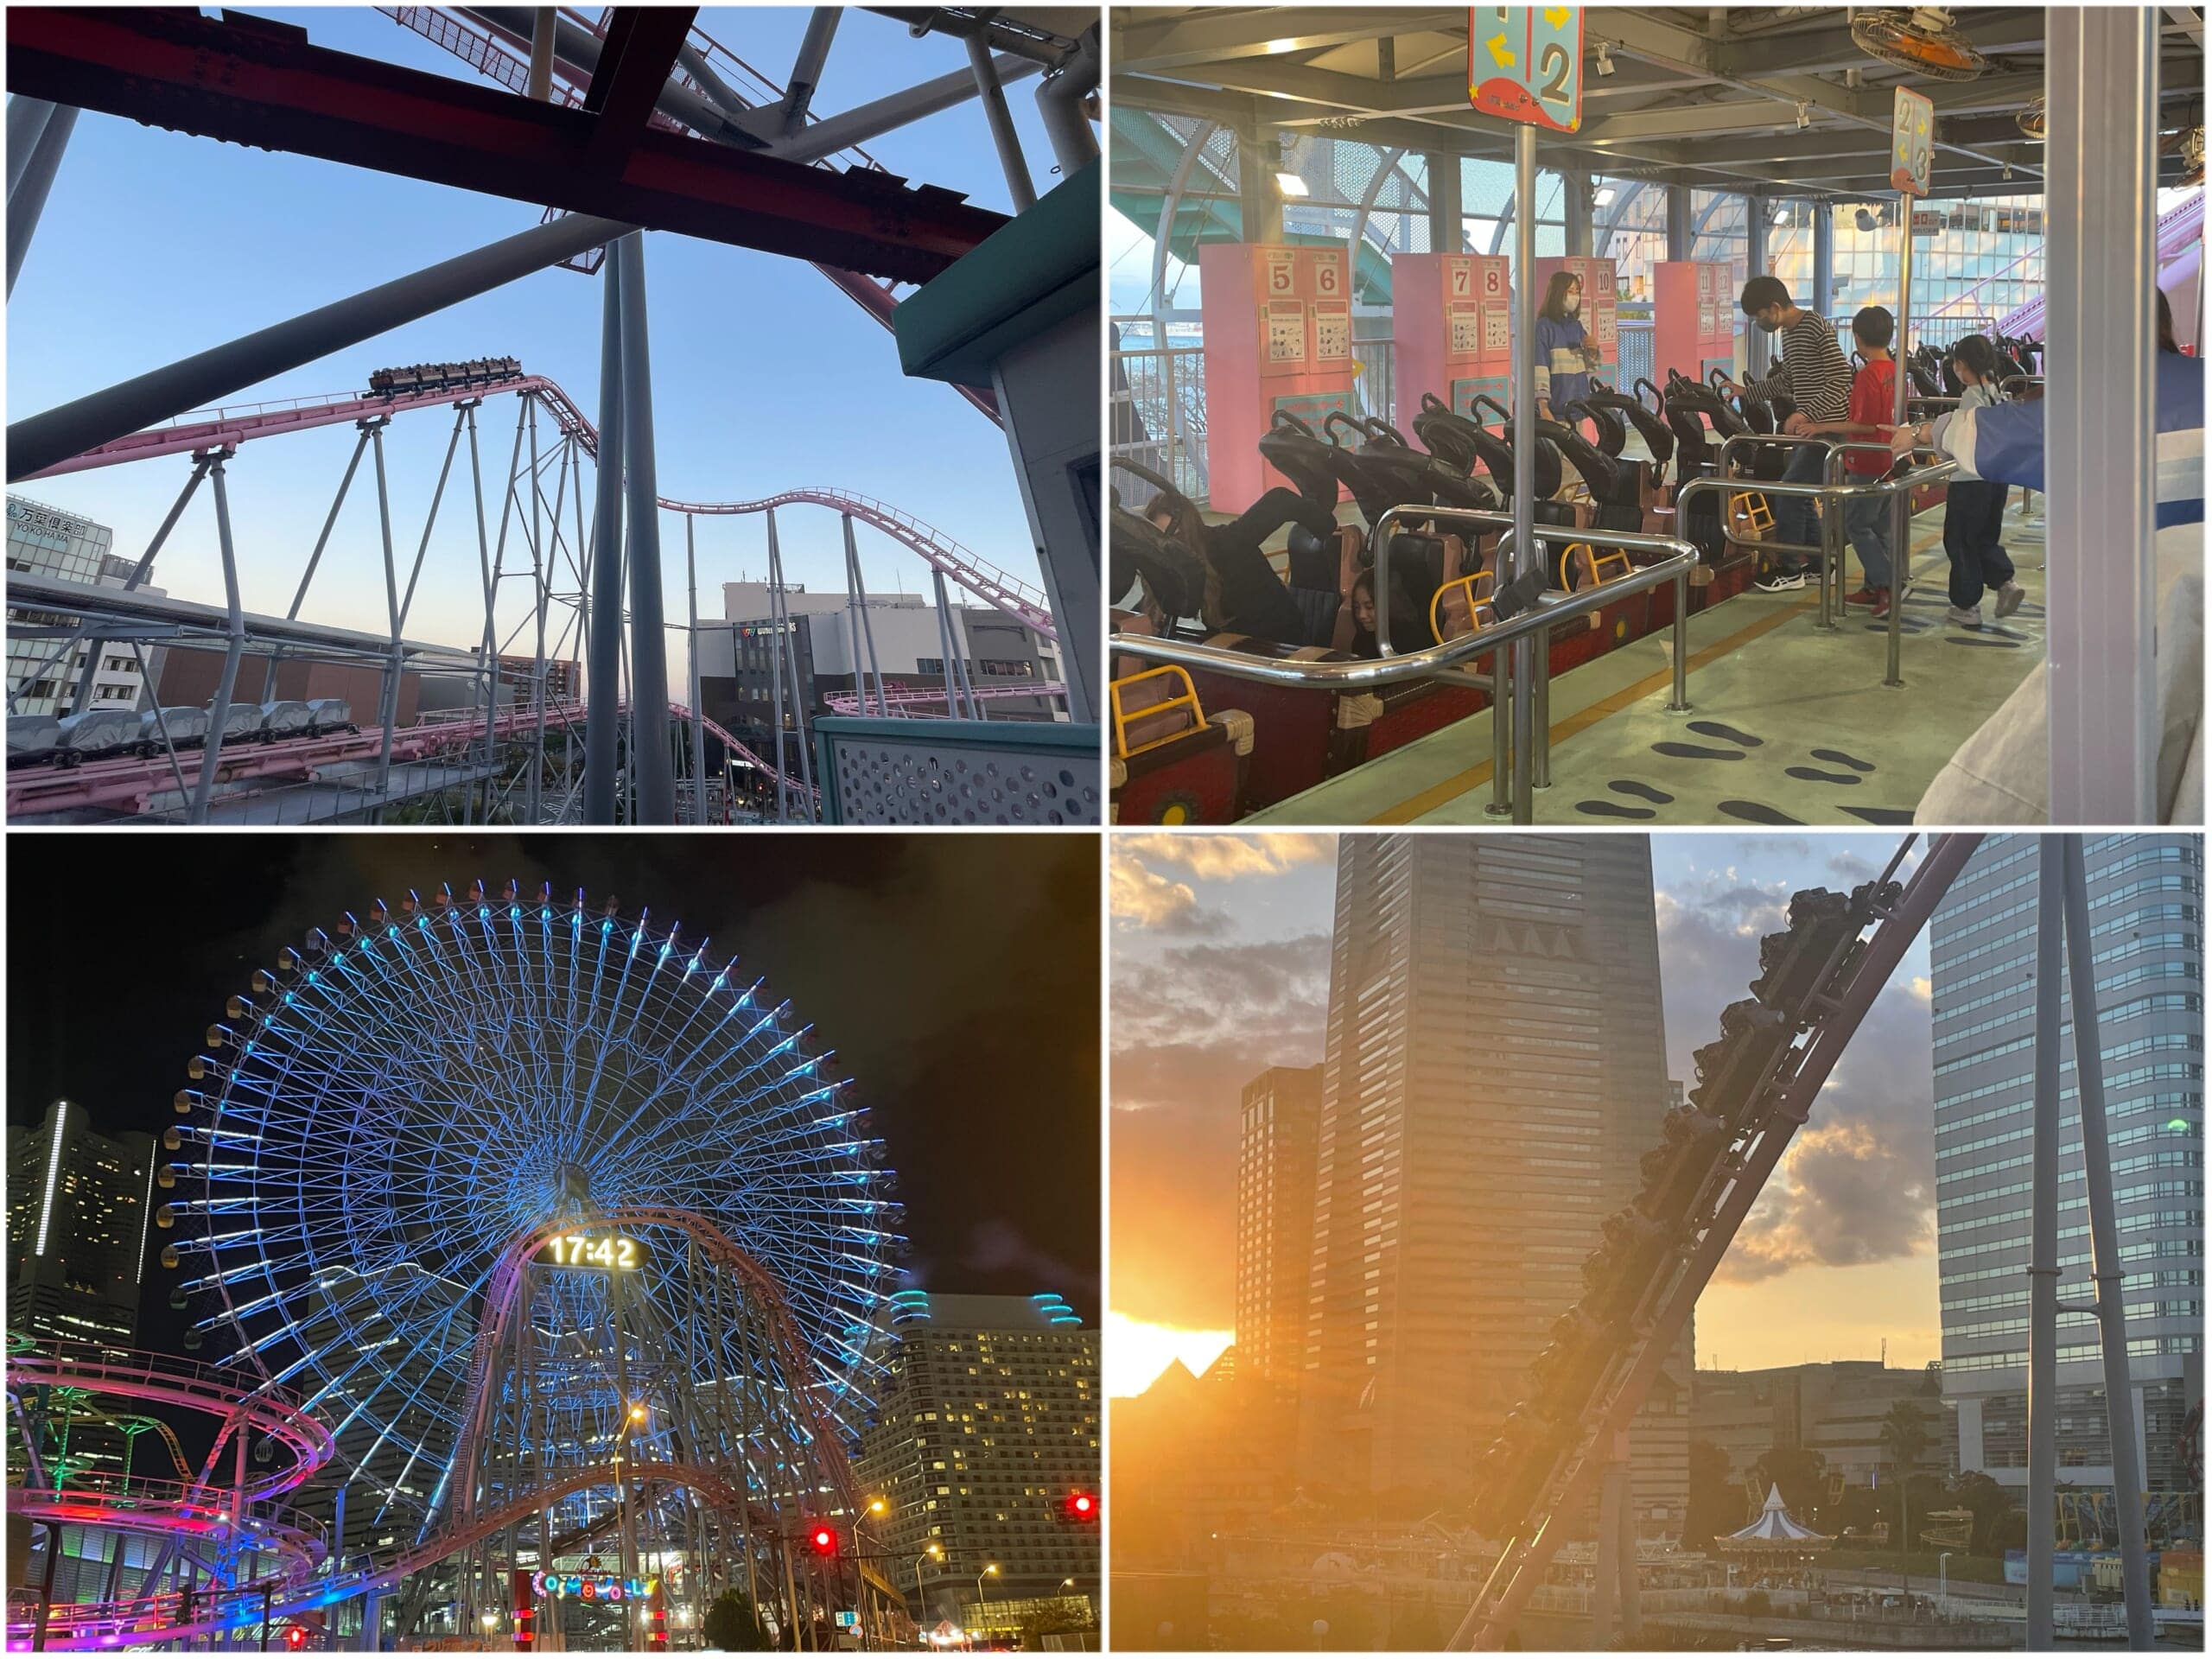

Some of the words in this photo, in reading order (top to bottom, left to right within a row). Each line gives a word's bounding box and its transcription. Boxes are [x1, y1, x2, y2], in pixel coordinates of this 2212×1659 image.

[1540, 42, 1570, 106] 2
[1898, 99, 1910, 135] 2
[1916, 146, 1928, 182] 3
[1273, 264, 1289, 289] 5
[1319, 269, 1335, 290] 6
[1455, 270, 1467, 291] 7
[1487, 271, 1498, 291] 8
[1599, 272, 1609, 290] 10
[19, 507, 86, 537] 万葉倶楽部
[550, 1236, 636, 1267] 17:42
